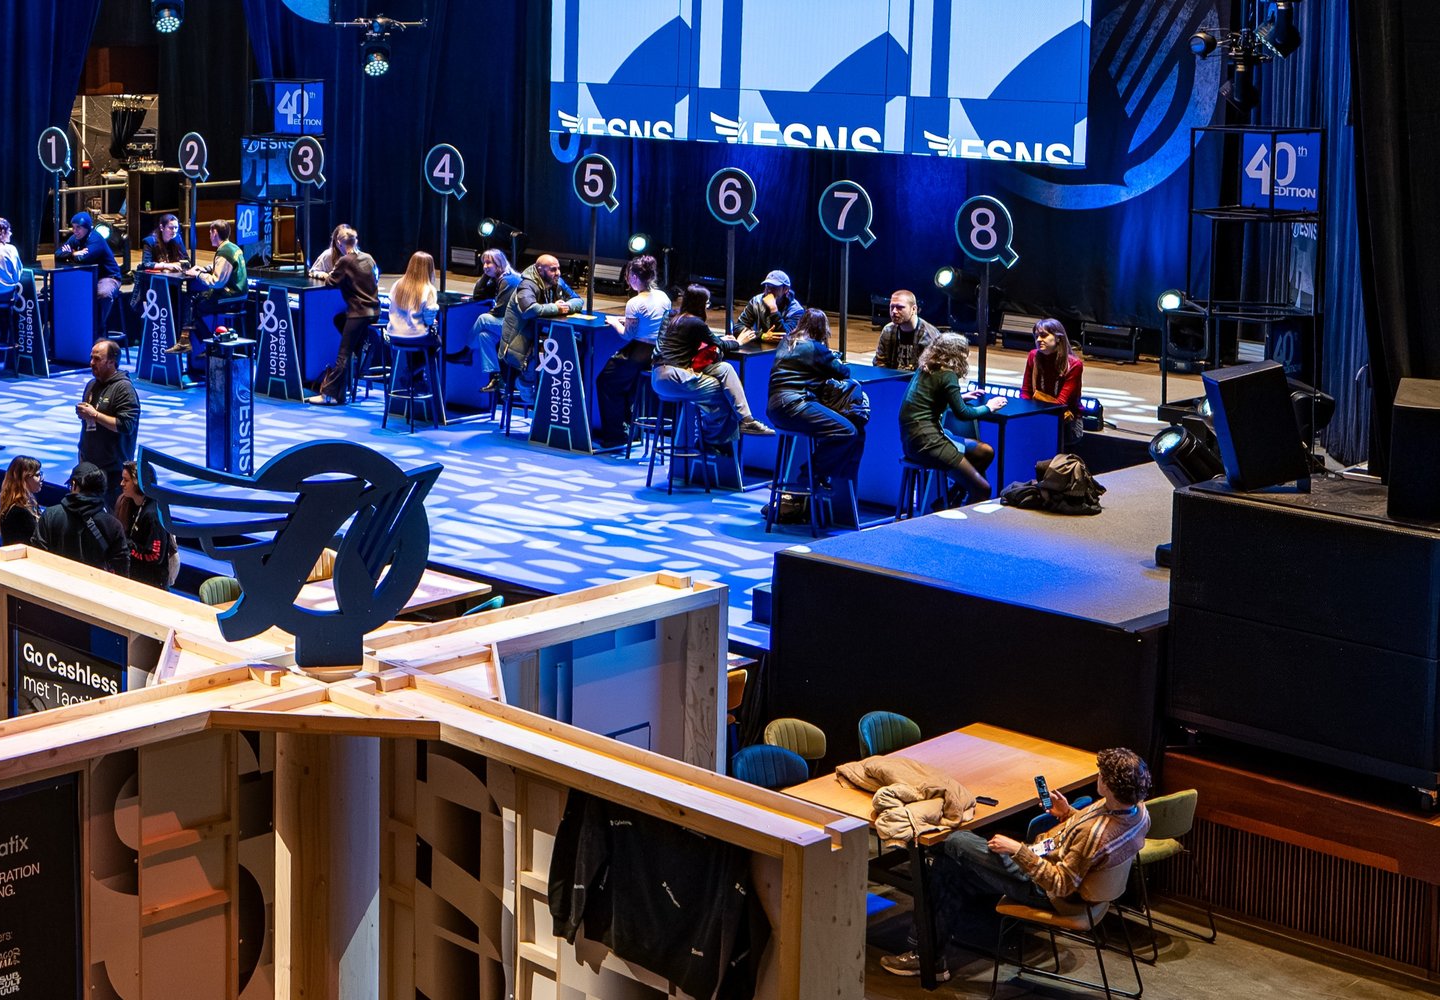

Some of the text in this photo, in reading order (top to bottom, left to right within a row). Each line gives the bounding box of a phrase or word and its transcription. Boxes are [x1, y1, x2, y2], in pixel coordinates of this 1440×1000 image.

[46, 135, 57, 165] 1
[185, 140, 199, 171] 2
[297, 145, 314, 176] 3
[432, 153, 455, 186] 4
[583, 163, 605, 198] 5
[718, 177, 742, 215] 6
[1273, 186, 1316, 199] EDITION
[834, 191, 859, 231] 7
[970, 207, 998, 251] 8
[18, 313, 26, 352] Action
[25, 299, 35, 354] Question
[141, 288, 160, 362] & Action
[160, 307, 168, 363] Question
[257, 299, 278, 375] & Action
[278, 319, 288, 377] Question
[535, 338, 562, 422] & Action
[561, 360, 574, 424] Question
[239, 405, 251, 472] ESNS
[23, 642, 118, 696] Go Cashless
[23, 675, 50, 700] met
